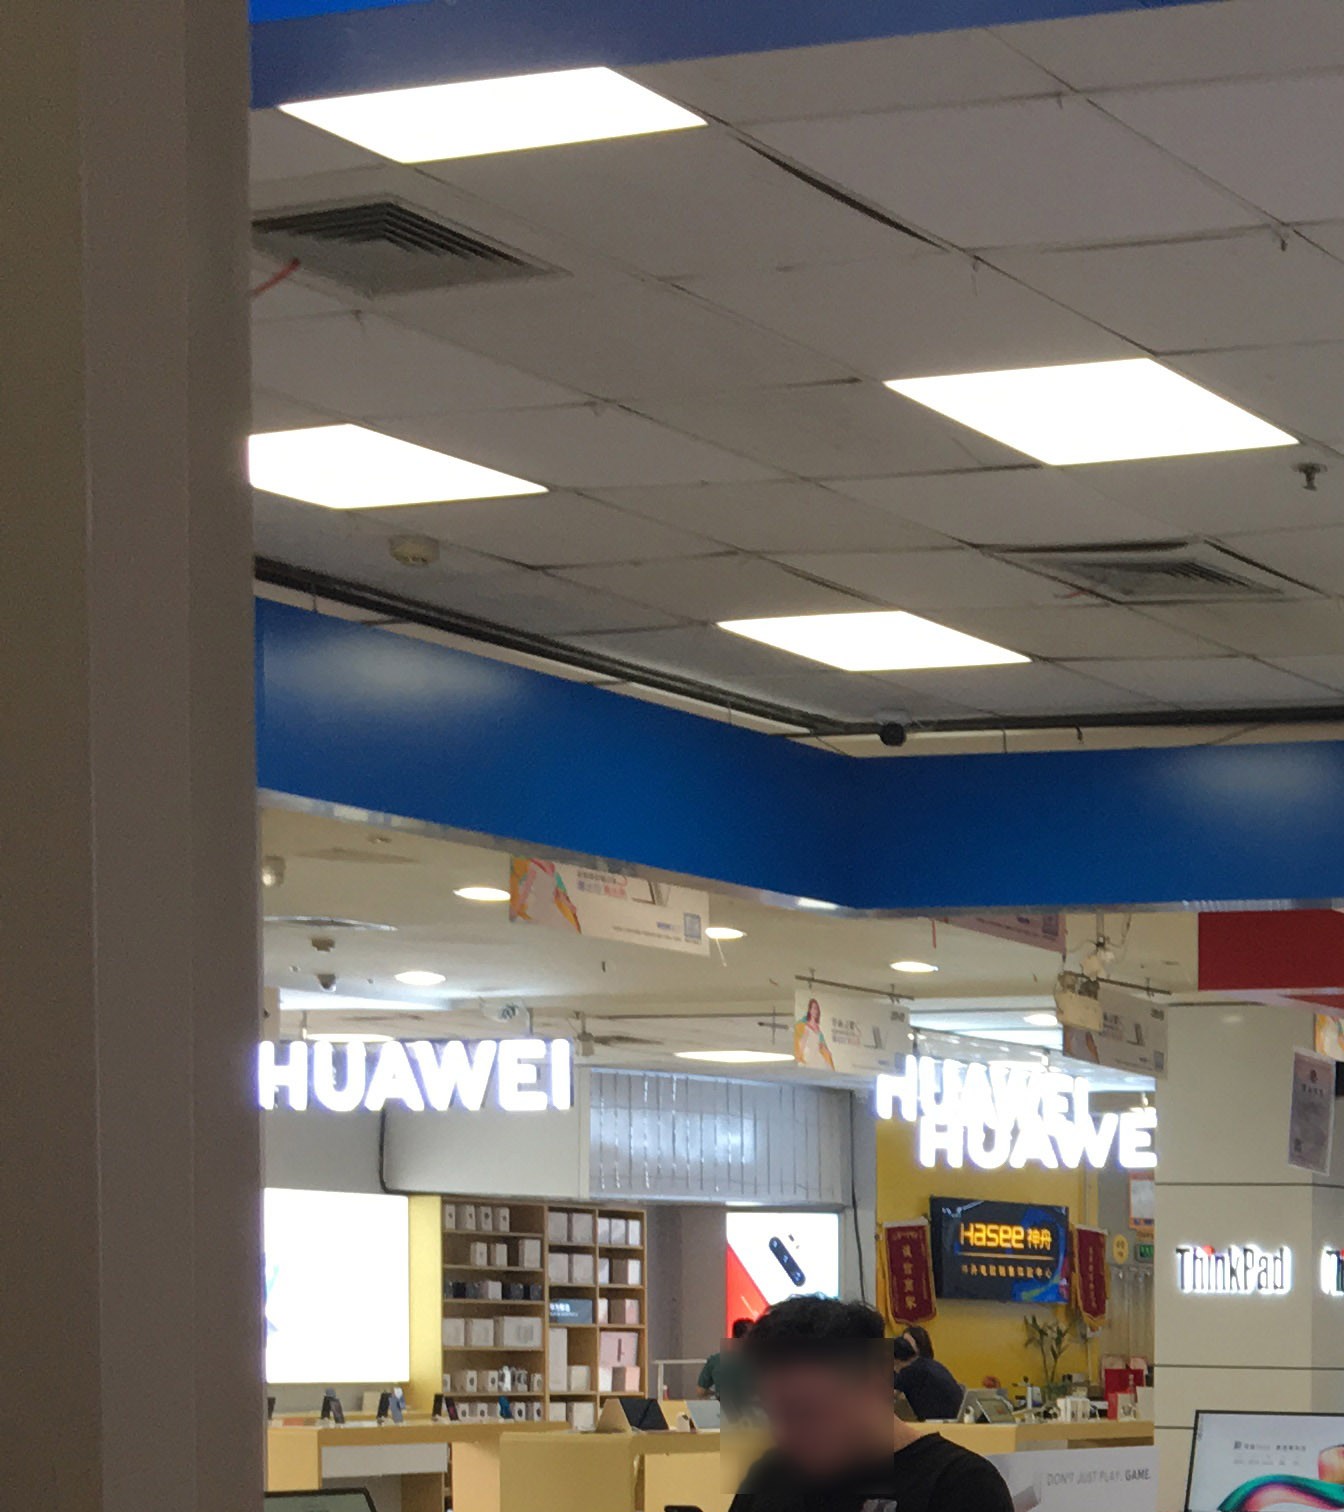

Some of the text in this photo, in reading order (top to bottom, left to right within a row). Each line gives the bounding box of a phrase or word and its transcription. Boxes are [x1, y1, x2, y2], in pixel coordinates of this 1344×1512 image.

[255, 1038, 572, 1112] HUAWEI
[959, 1222, 1026, 1250] Hasee
[1175, 1246, 1287, 1292] ThinkPad
